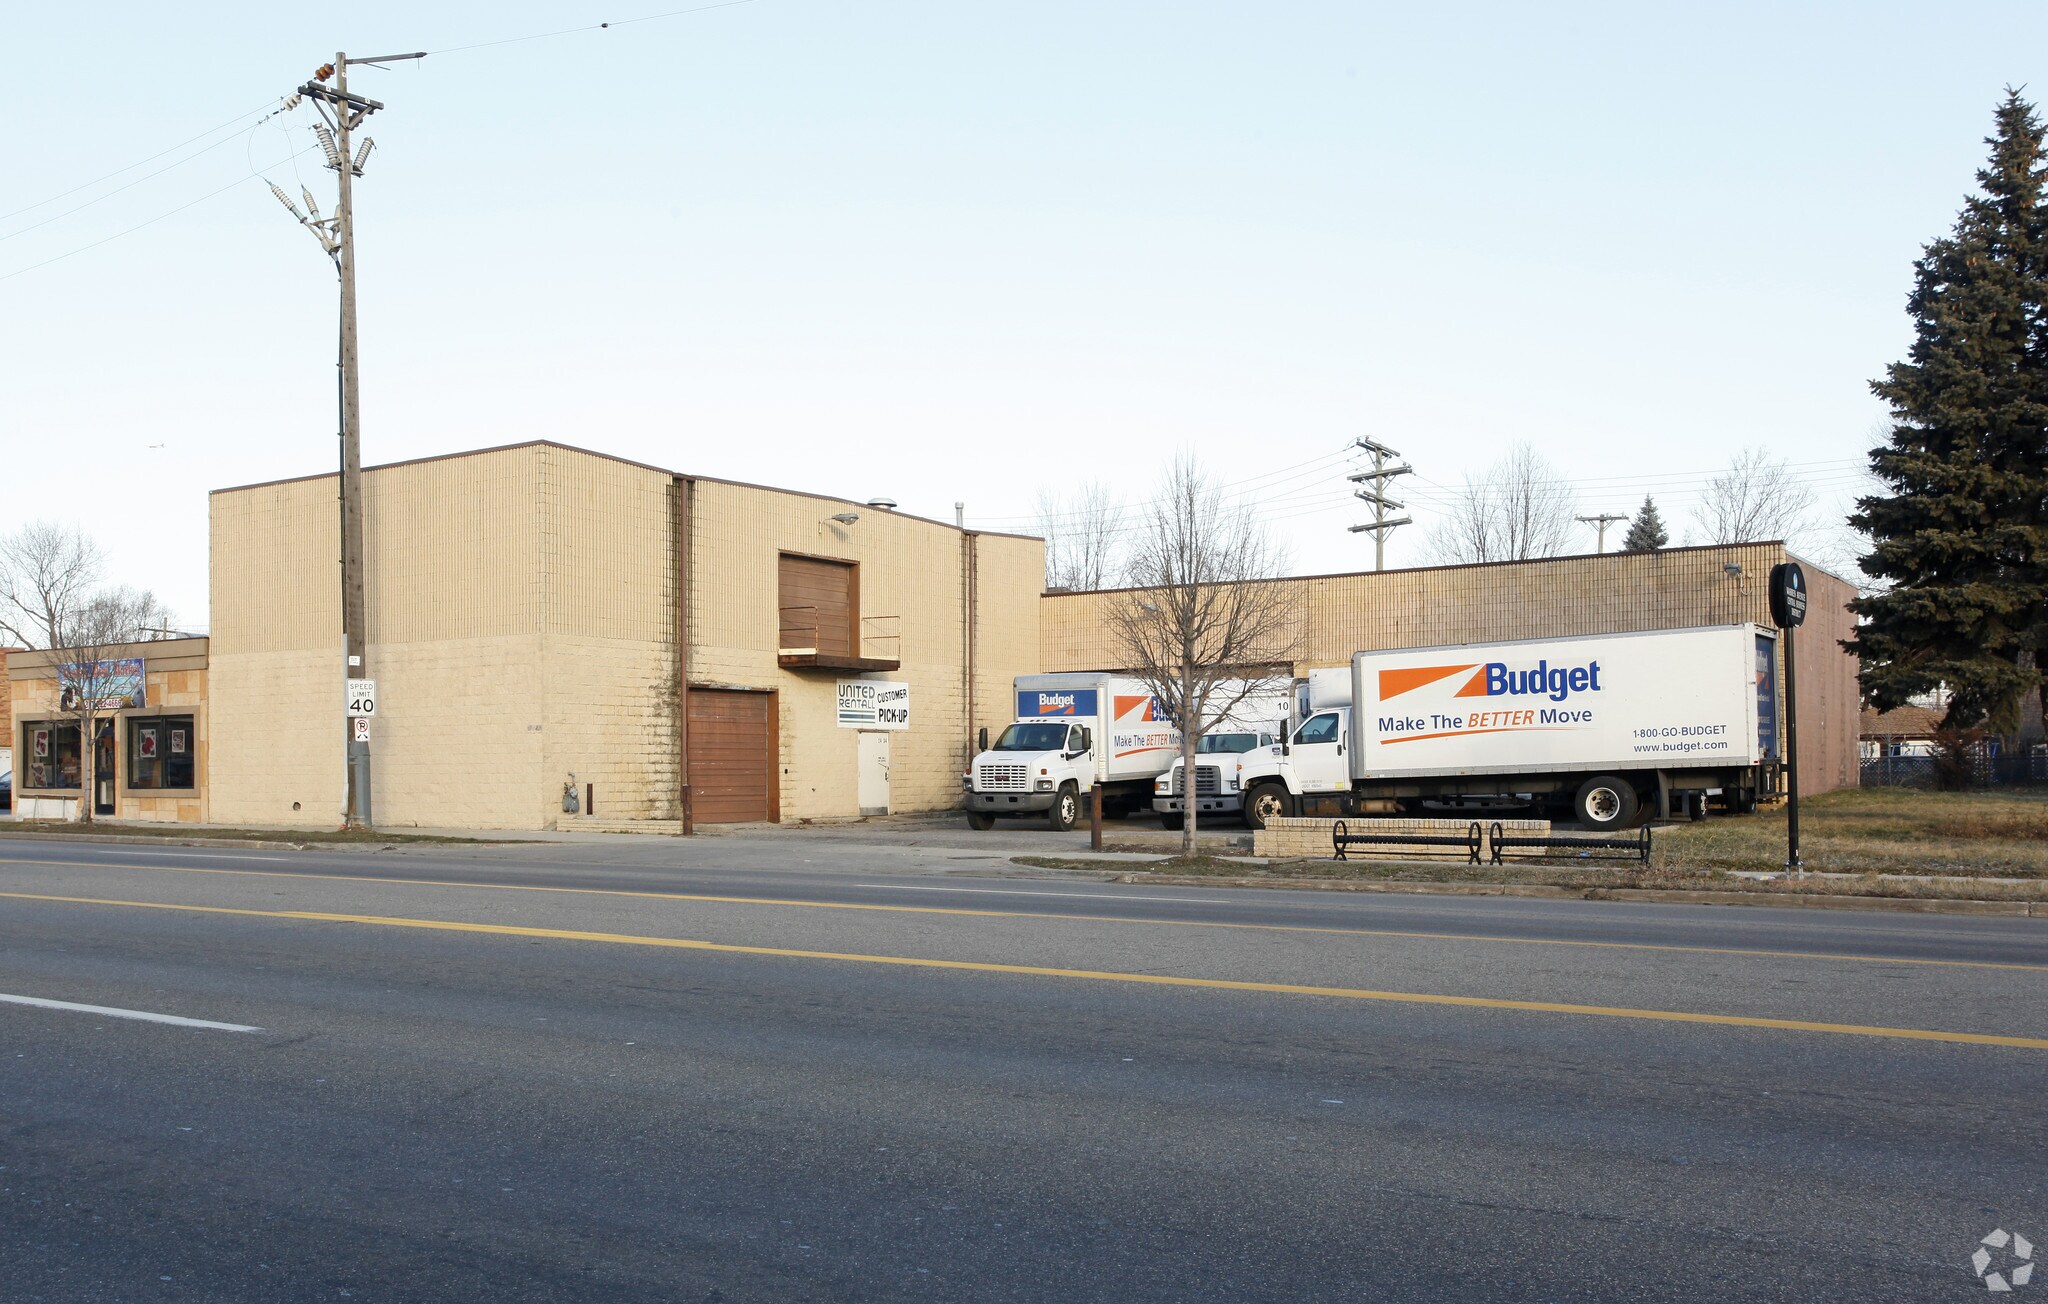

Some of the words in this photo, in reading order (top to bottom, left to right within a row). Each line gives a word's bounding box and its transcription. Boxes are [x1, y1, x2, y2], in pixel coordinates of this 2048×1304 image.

[1486, 660, 1600, 702] Budget
[839, 685, 875, 699] UNITED
[877, 689, 908, 704] CUSTOMER
[350, 699, 374, 712] 40
[1039, 693, 1075, 708] Budget
[1278, 702, 1289, 710] 10
[879, 708, 908, 723] PICK-UP
[1378, 717, 1425, 731] Make
[1431, 715, 1462, 729] The
[1468, 710, 1535, 727] BETTER
[1540, 709, 1592, 723] Move
[1633, 725, 1727, 738] 1-800-GO-BUDGET
[1114, 735, 1132, 747] Make
[1134, 735, 1145, 746] The
[1146, 734, 1168, 746] BETTER
[1634, 741, 1728, 752] www.budget.com
